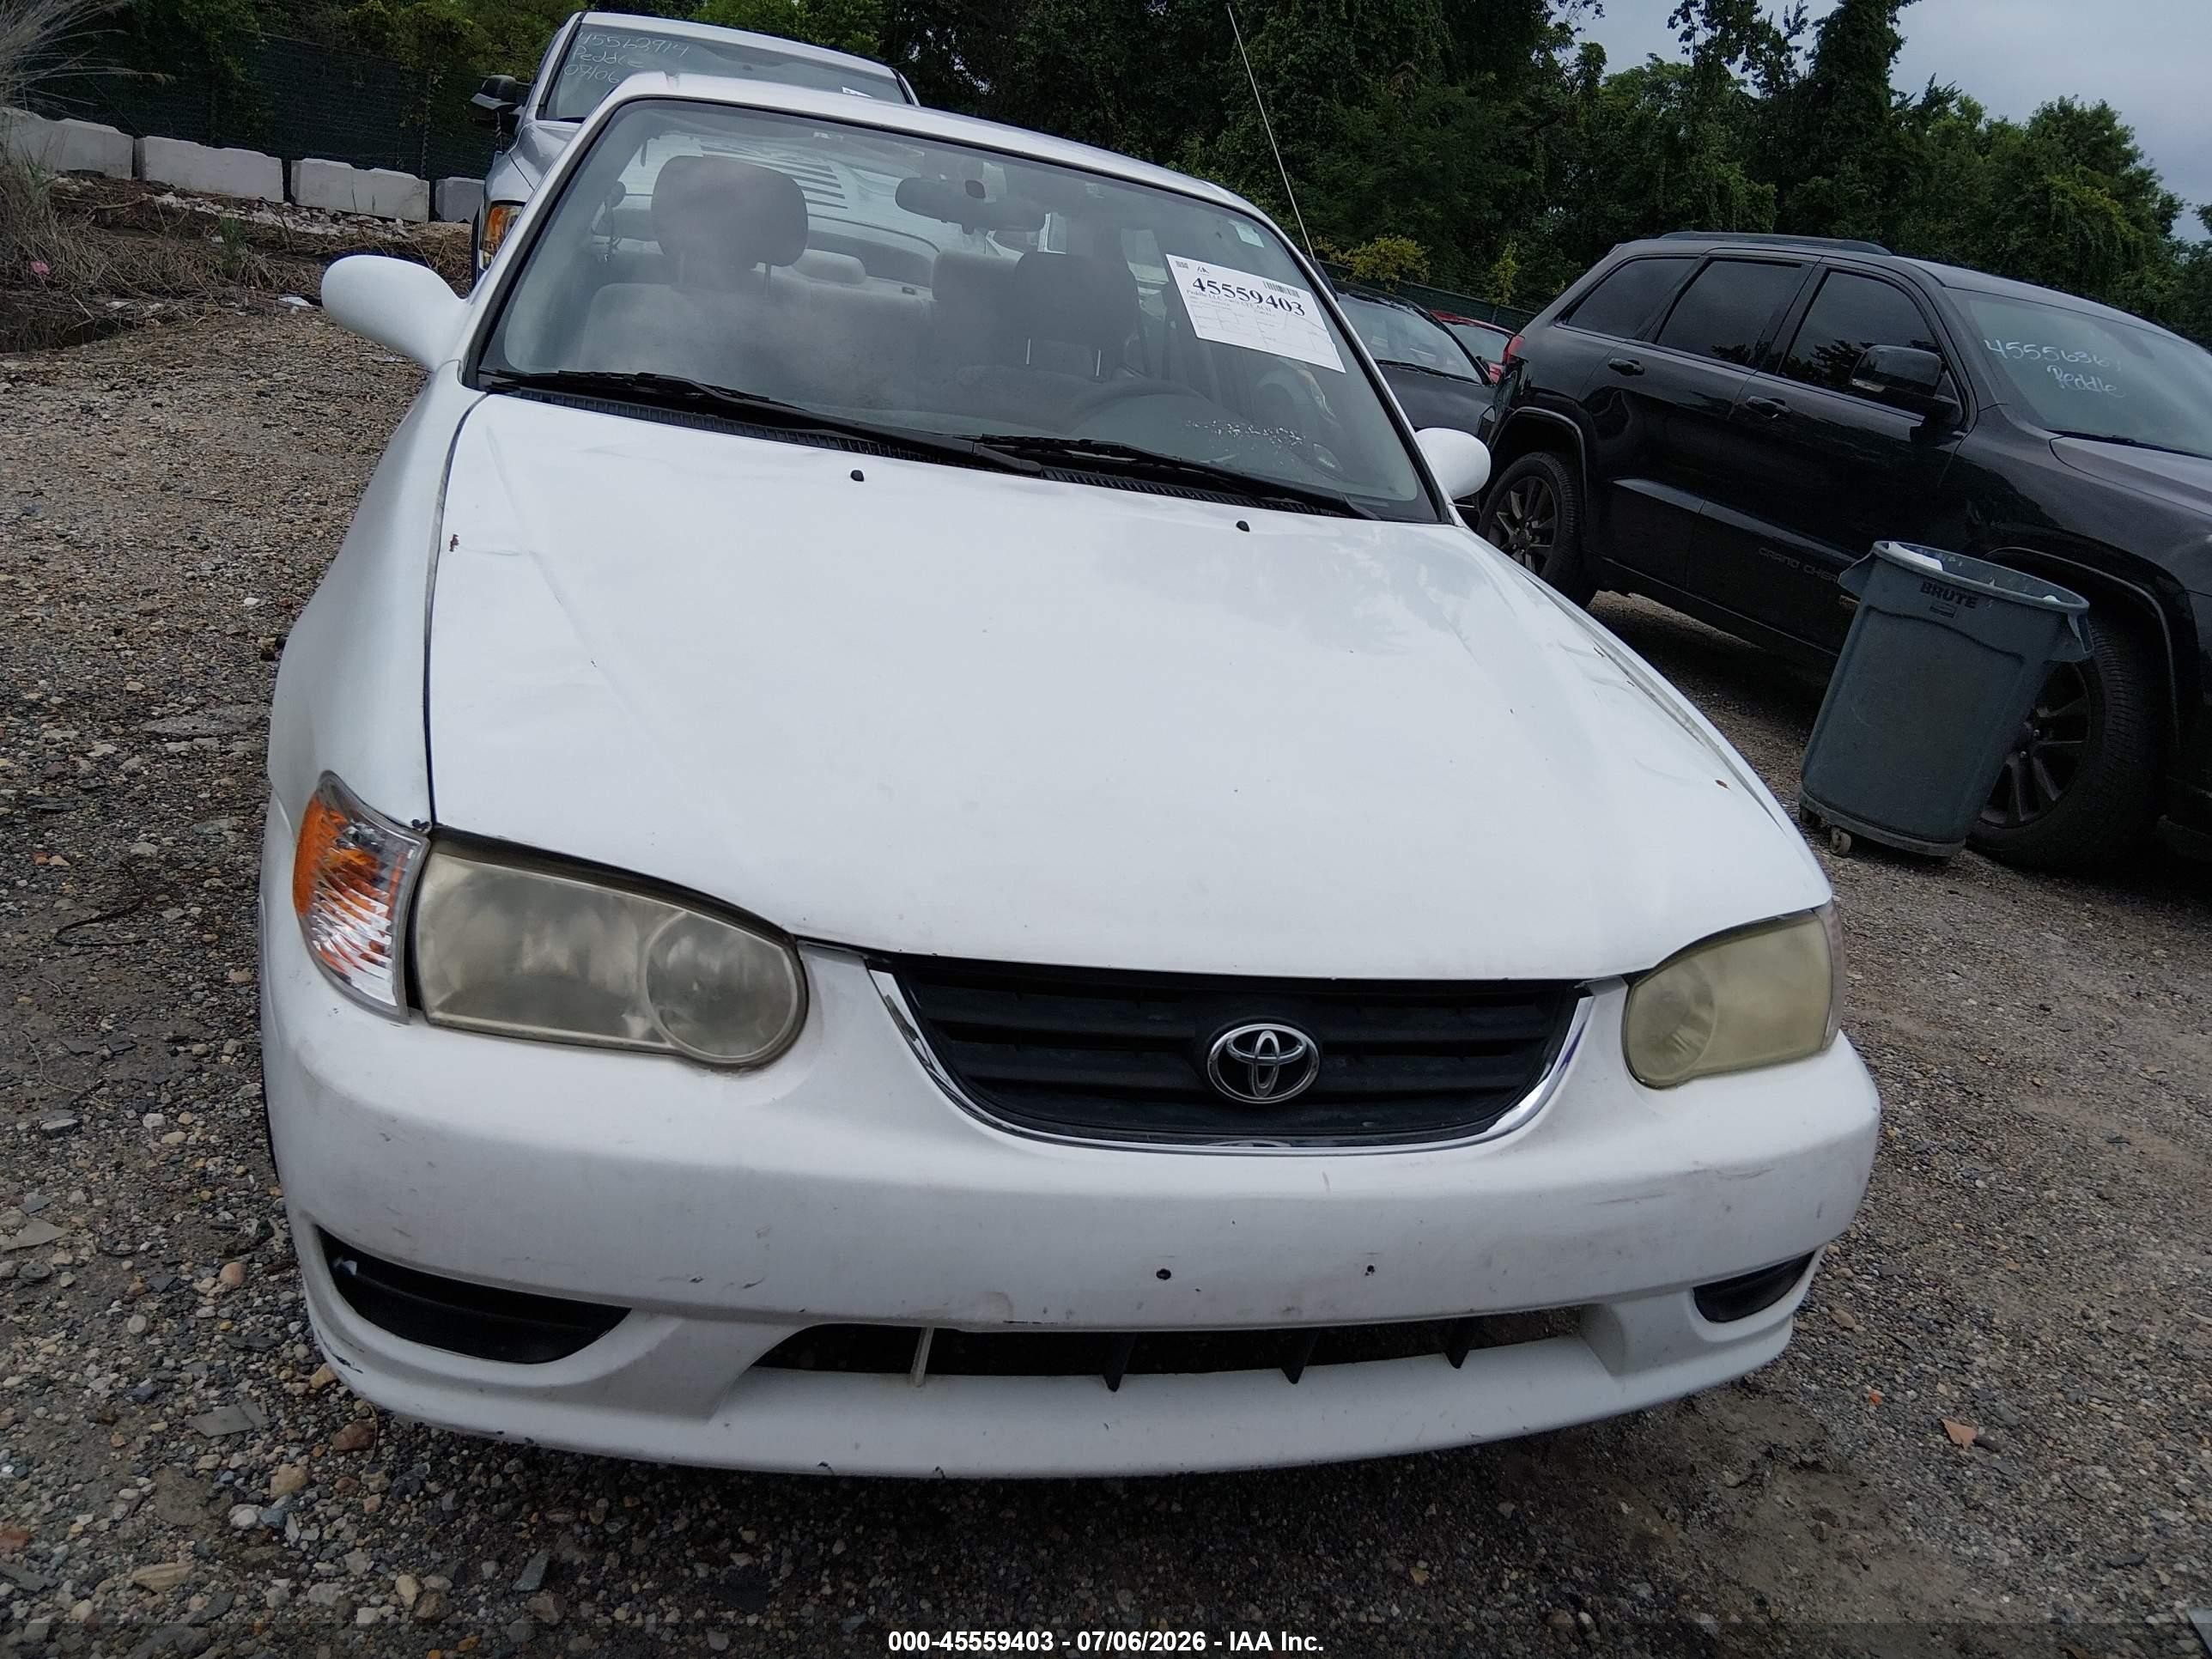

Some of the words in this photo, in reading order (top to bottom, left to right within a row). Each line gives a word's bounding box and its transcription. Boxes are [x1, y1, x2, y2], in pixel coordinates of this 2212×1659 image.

[1192, 277, 1305, 317] 45559403
[2046, 365, 2126, 398] Peddle
[1920, 581, 1978, 609] BRUTE
